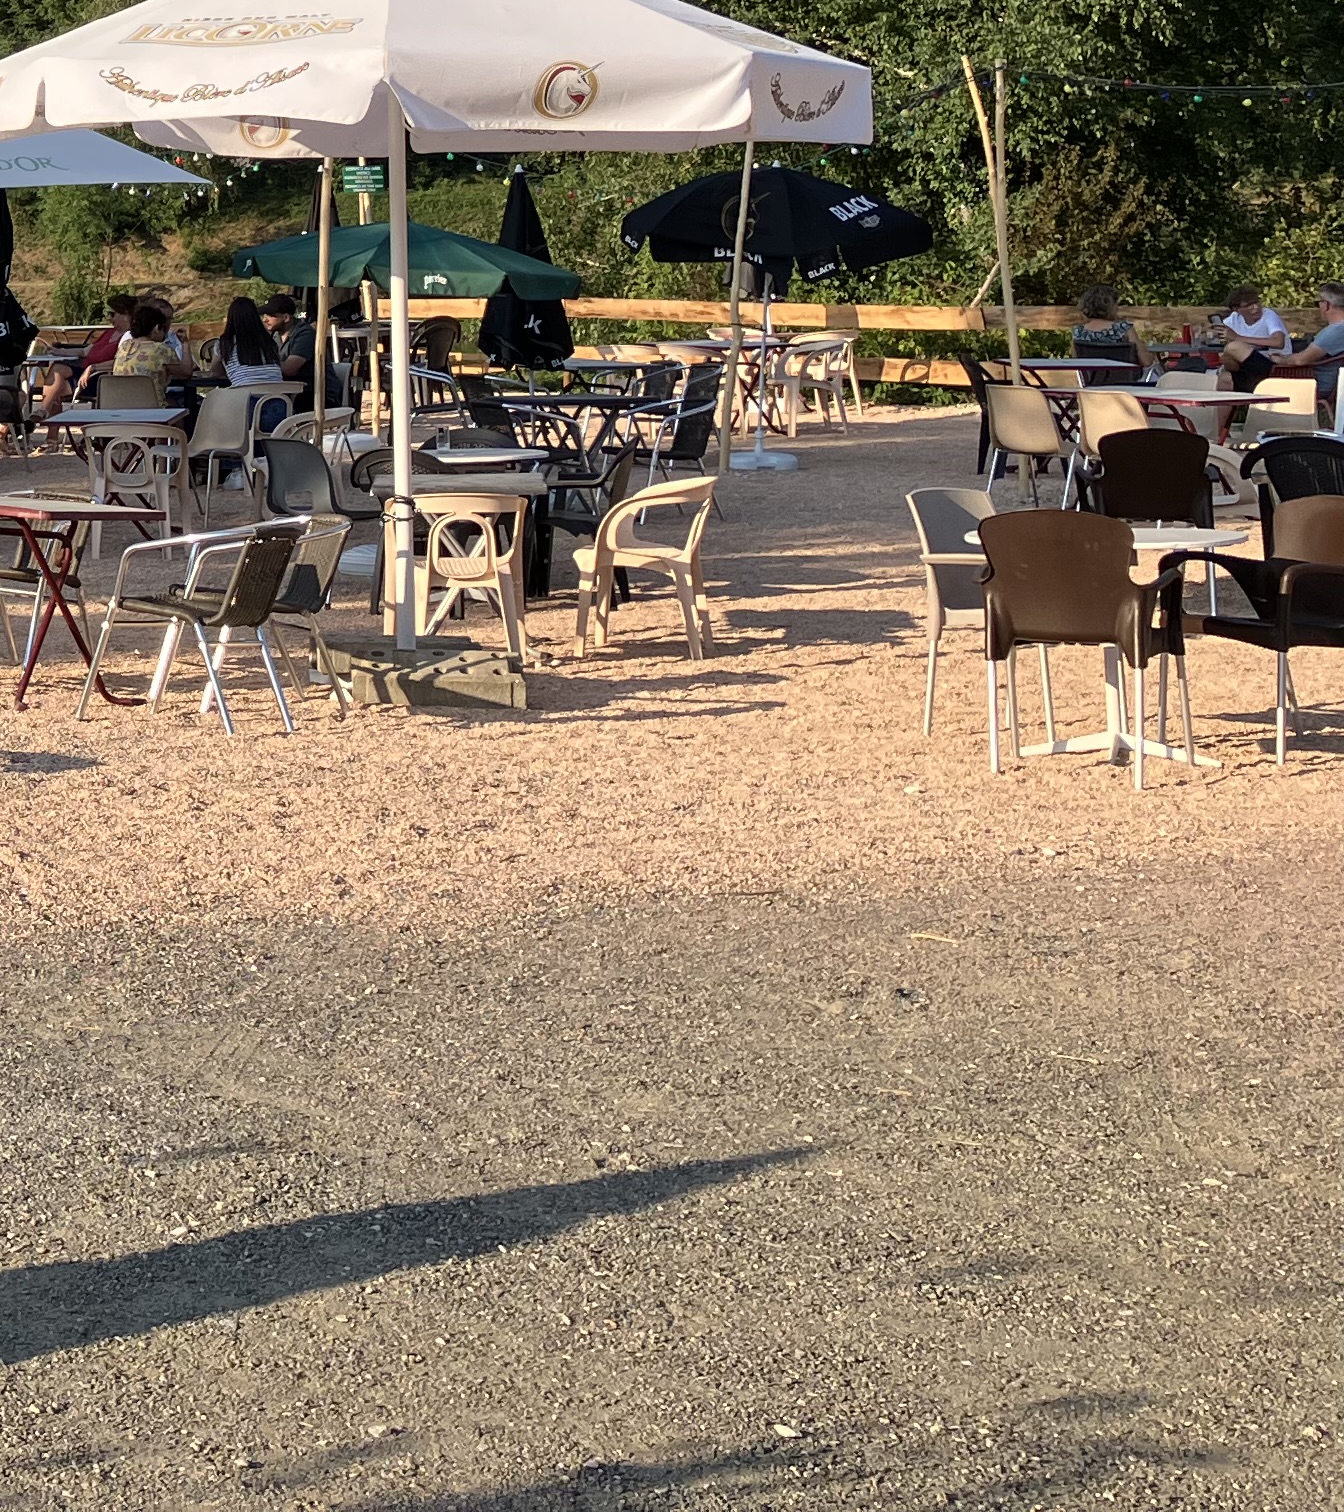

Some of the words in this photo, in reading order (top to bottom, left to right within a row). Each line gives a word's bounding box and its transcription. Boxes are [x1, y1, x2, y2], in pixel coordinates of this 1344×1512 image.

[120, 18, 363, 46] LICORNE
[828, 195, 879, 222] BLACK
[807, 262, 836, 280] BLACK
